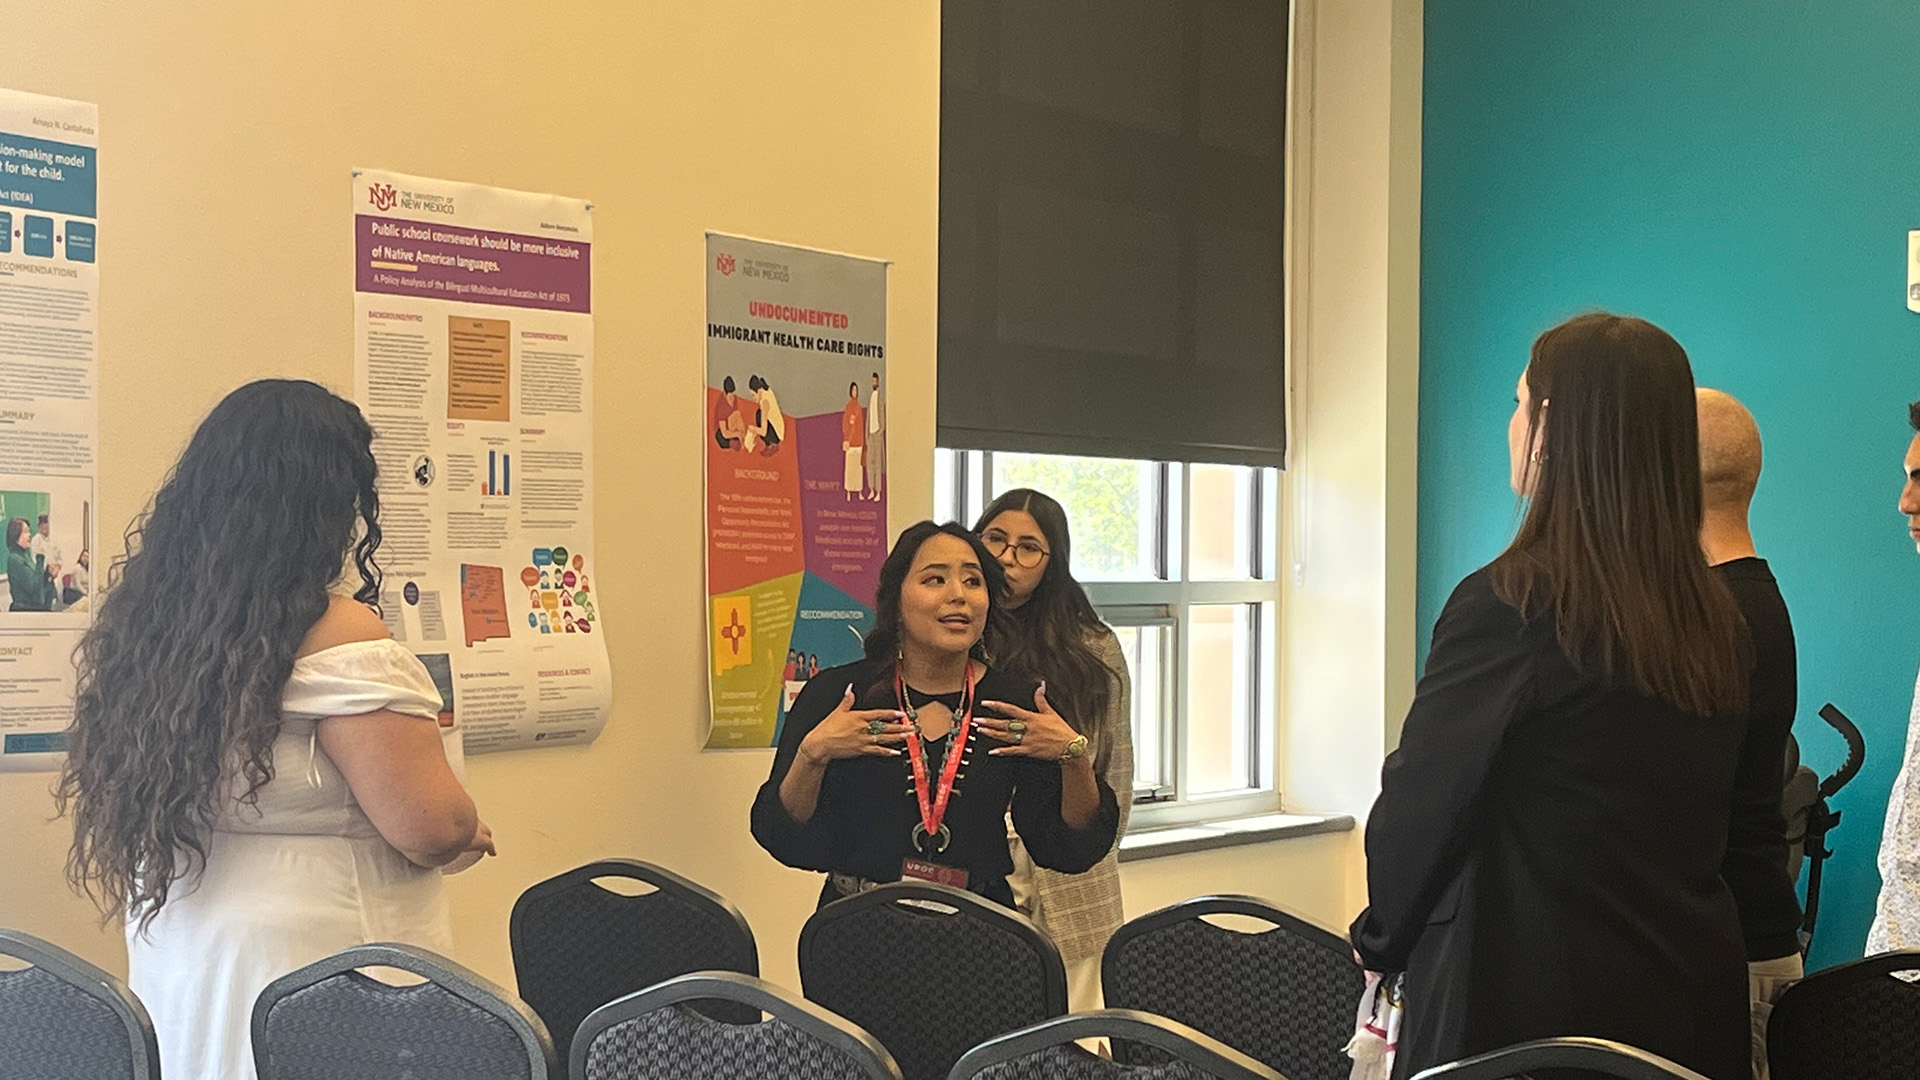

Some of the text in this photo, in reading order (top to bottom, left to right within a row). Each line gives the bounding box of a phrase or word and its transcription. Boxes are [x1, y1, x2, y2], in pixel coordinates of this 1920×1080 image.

[0, 144, 85, 168] ion-making model
[5, 160, 18, 174] for
[22, 164, 38, 177] the
[39, 166, 65, 181] child.
[401, 198, 454, 214] NEW MEXICO
[372, 222, 580, 259] Public school coursework should be more inclusive
[372, 245, 500, 272] of Native American languages.
[742, 266, 790, 283] NEW MEXICO
[374, 274, 380, 284] A
[381, 275, 400, 287] Policy
[400, 276, 426, 290] Analysis
[427, 280, 434, 289] of
[434, 281, 444, 290] the
[509, 288, 538, 299] Education
[538, 292, 548, 300] Act
[548, 292, 555, 301] of
[749, 300, 848, 330] UNDOCUMENTED
[708, 323, 884, 358] IMMIGRANT HEALTH CARE RIGHTS
[0, 647, 33, 656] ONTACT
